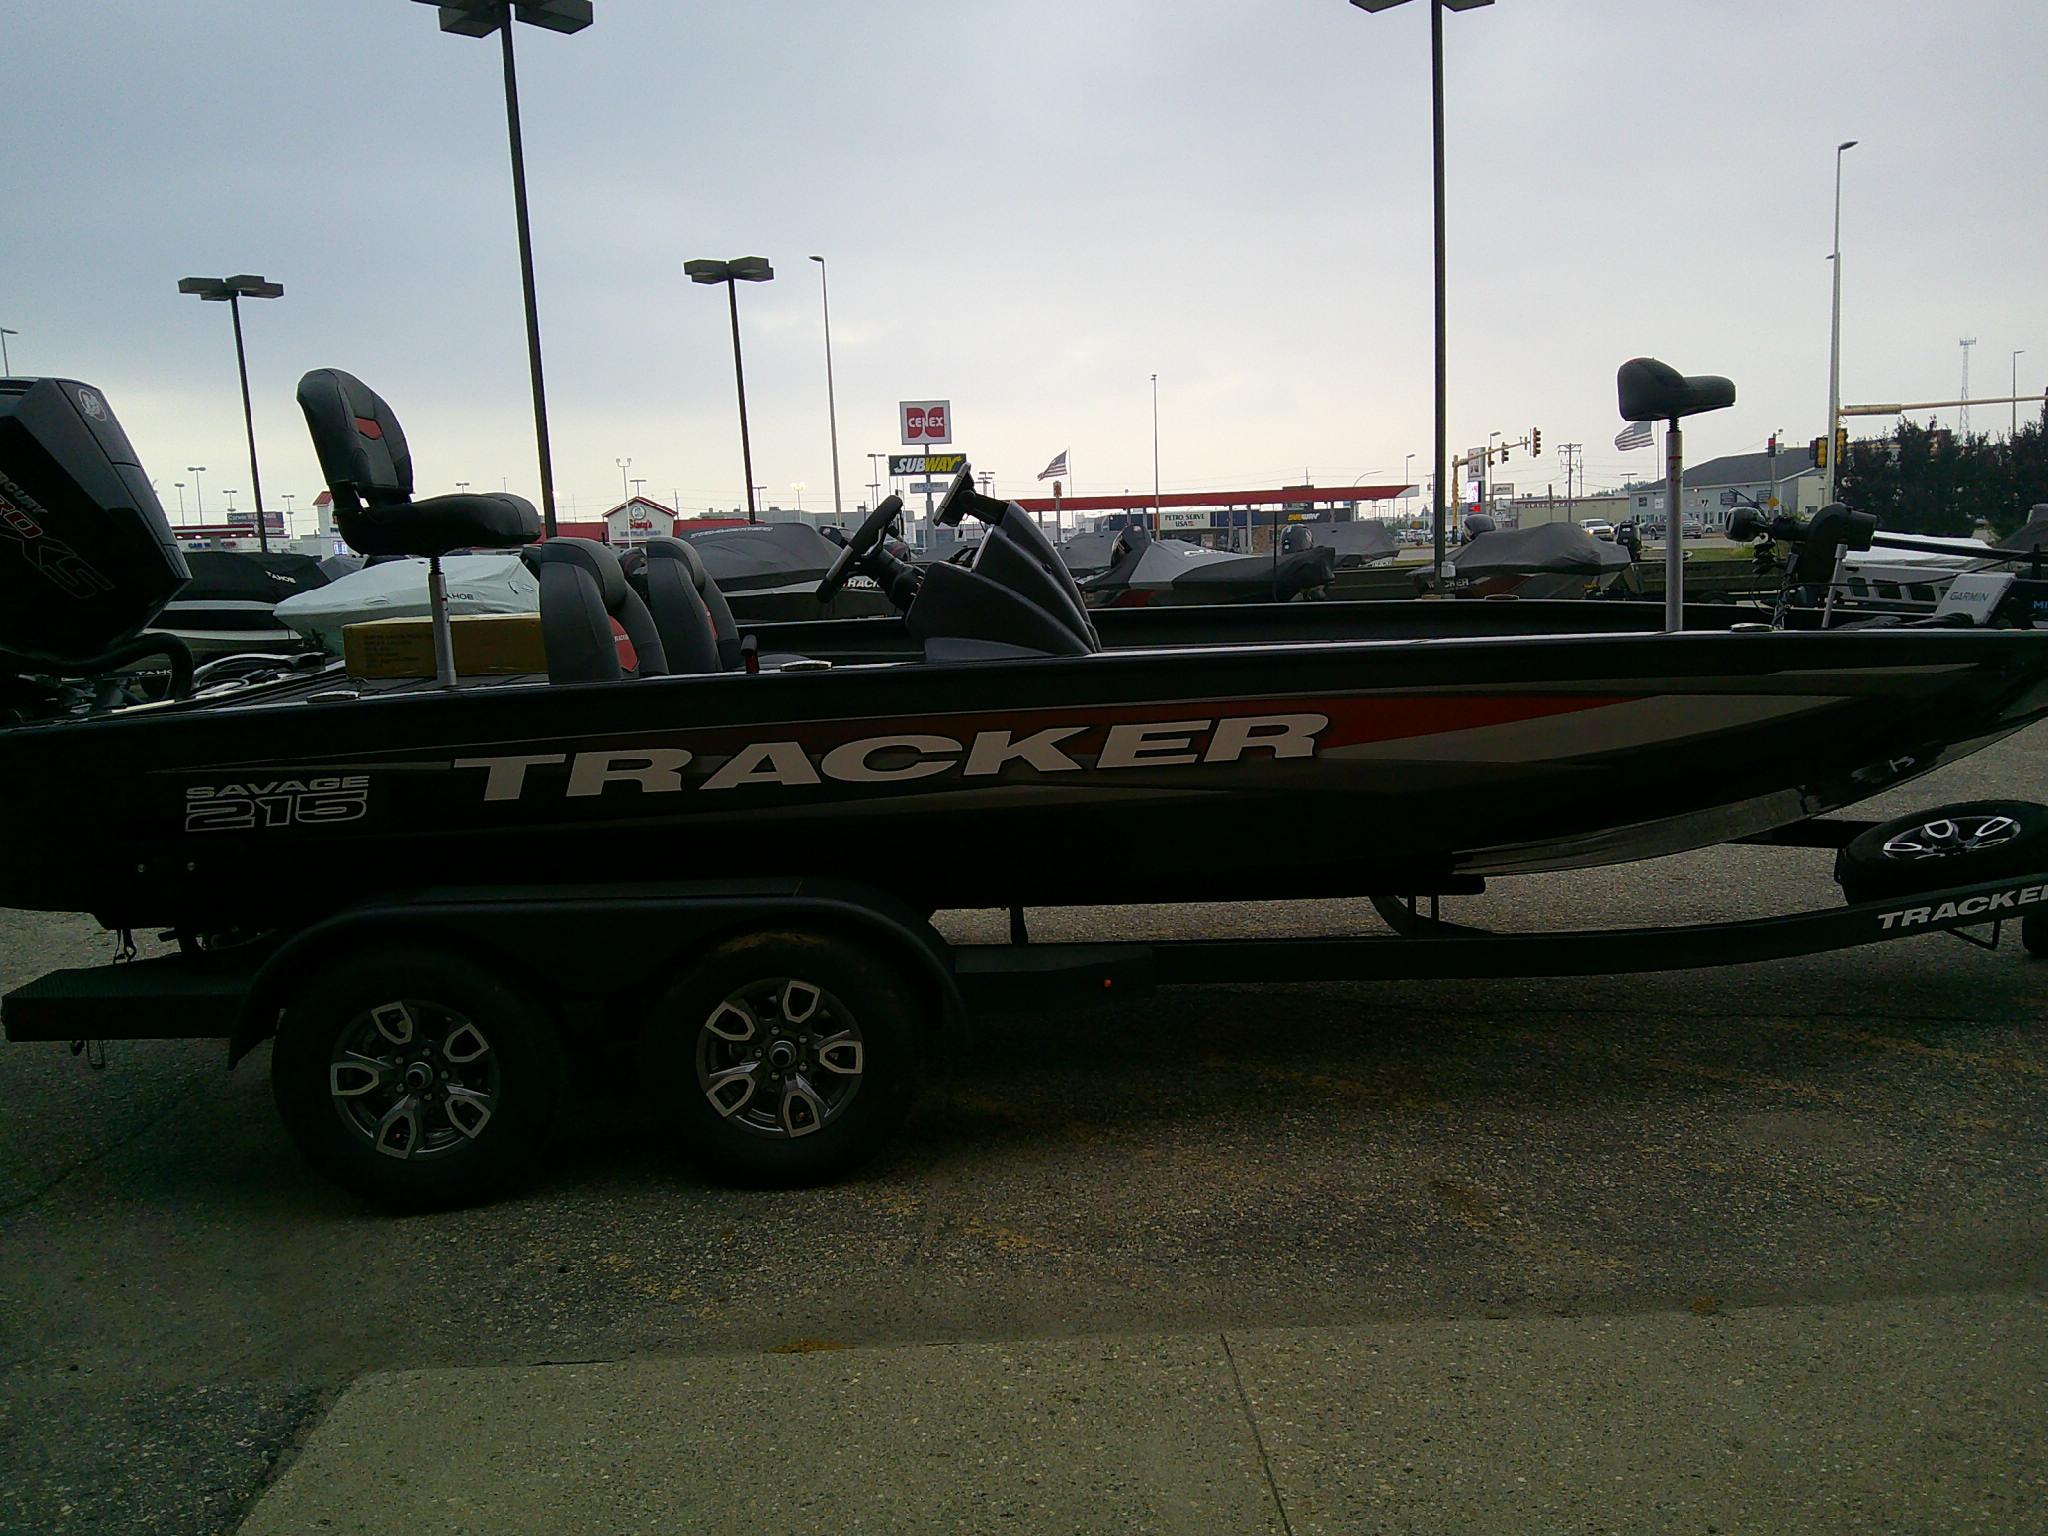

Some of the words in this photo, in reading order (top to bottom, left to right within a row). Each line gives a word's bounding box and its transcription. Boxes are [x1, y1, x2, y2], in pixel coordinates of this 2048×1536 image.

[908, 416, 944, 428] CENEX
[894, 455, 961, 473] SUBWAY
[1950, 591, 1990, 601] GARMIN
[453, 712, 1329, 802] TRACKER
[185, 775, 371, 800] SAVAGE
[184, 789, 369, 833] 215
[1876, 884, 2048, 930] TRACKE
